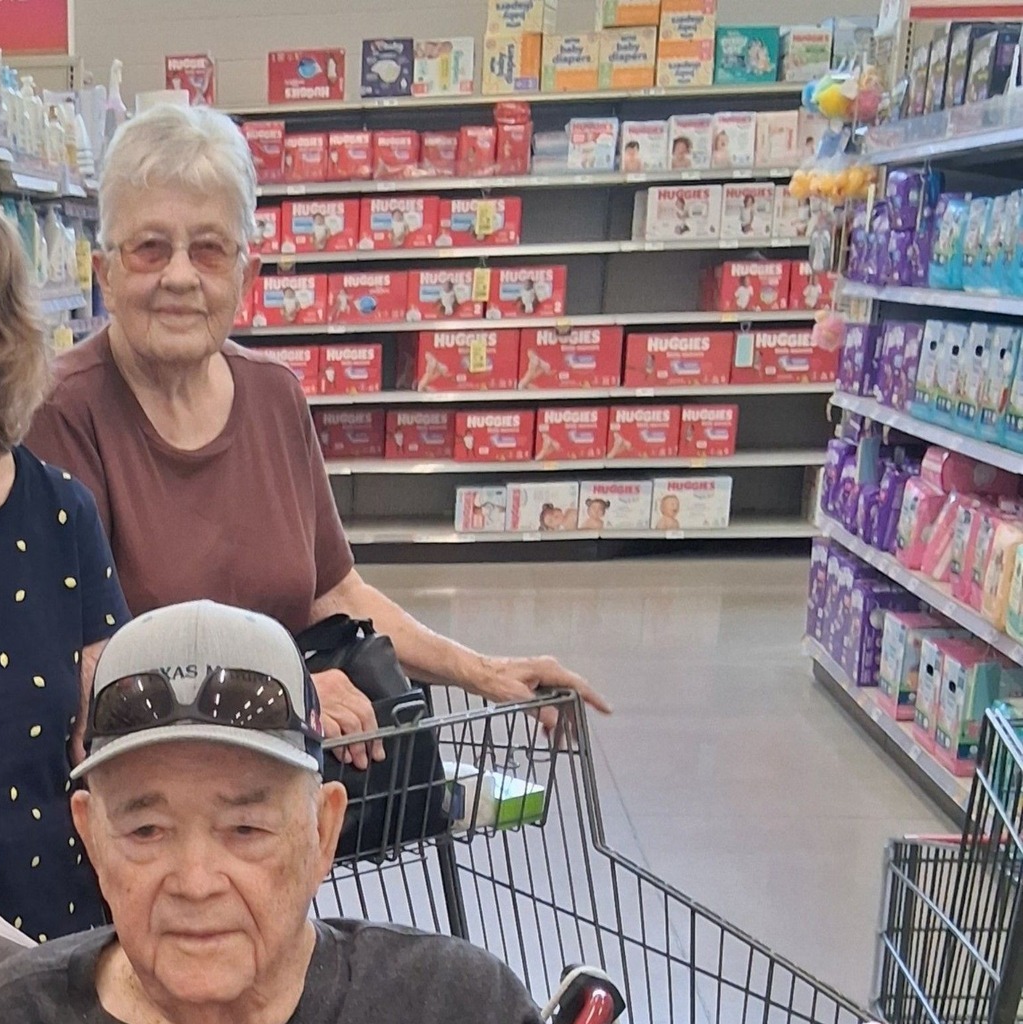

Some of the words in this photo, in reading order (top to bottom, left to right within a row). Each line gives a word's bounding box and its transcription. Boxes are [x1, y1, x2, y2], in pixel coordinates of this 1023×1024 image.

[658, 189, 710, 201] HUGGIES
[726, 187, 773, 199] HUGGIES
[292, 202, 345, 216] HUGGIES
[371, 199, 424, 213] HUGGIES
[451, 200, 506, 213] HUGES
[500, 268, 553, 283] HUGGIES
[732, 263, 782, 276] HUGGIES
[263, 276, 315, 290] HUGGIES
[344, 275, 391, 287] HUGGIES
[420, 271, 472, 284] HUGGIES
[433, 332, 497, 348] HUGGIES
[647, 337, 710, 352] HUGGIES
[326, 348, 375, 361] HUGGIES
[397, 413, 448, 425] HUGGIES
[466, 415, 521, 428] HUGGIES
[543, 410, 598, 423] HUGGIES
[616, 409, 671, 422] HUGGIES
[682, 409, 733, 421] HUGGIES
[593, 484, 640, 495] HUGGIES
[667, 480, 715, 492] HUGGIES
